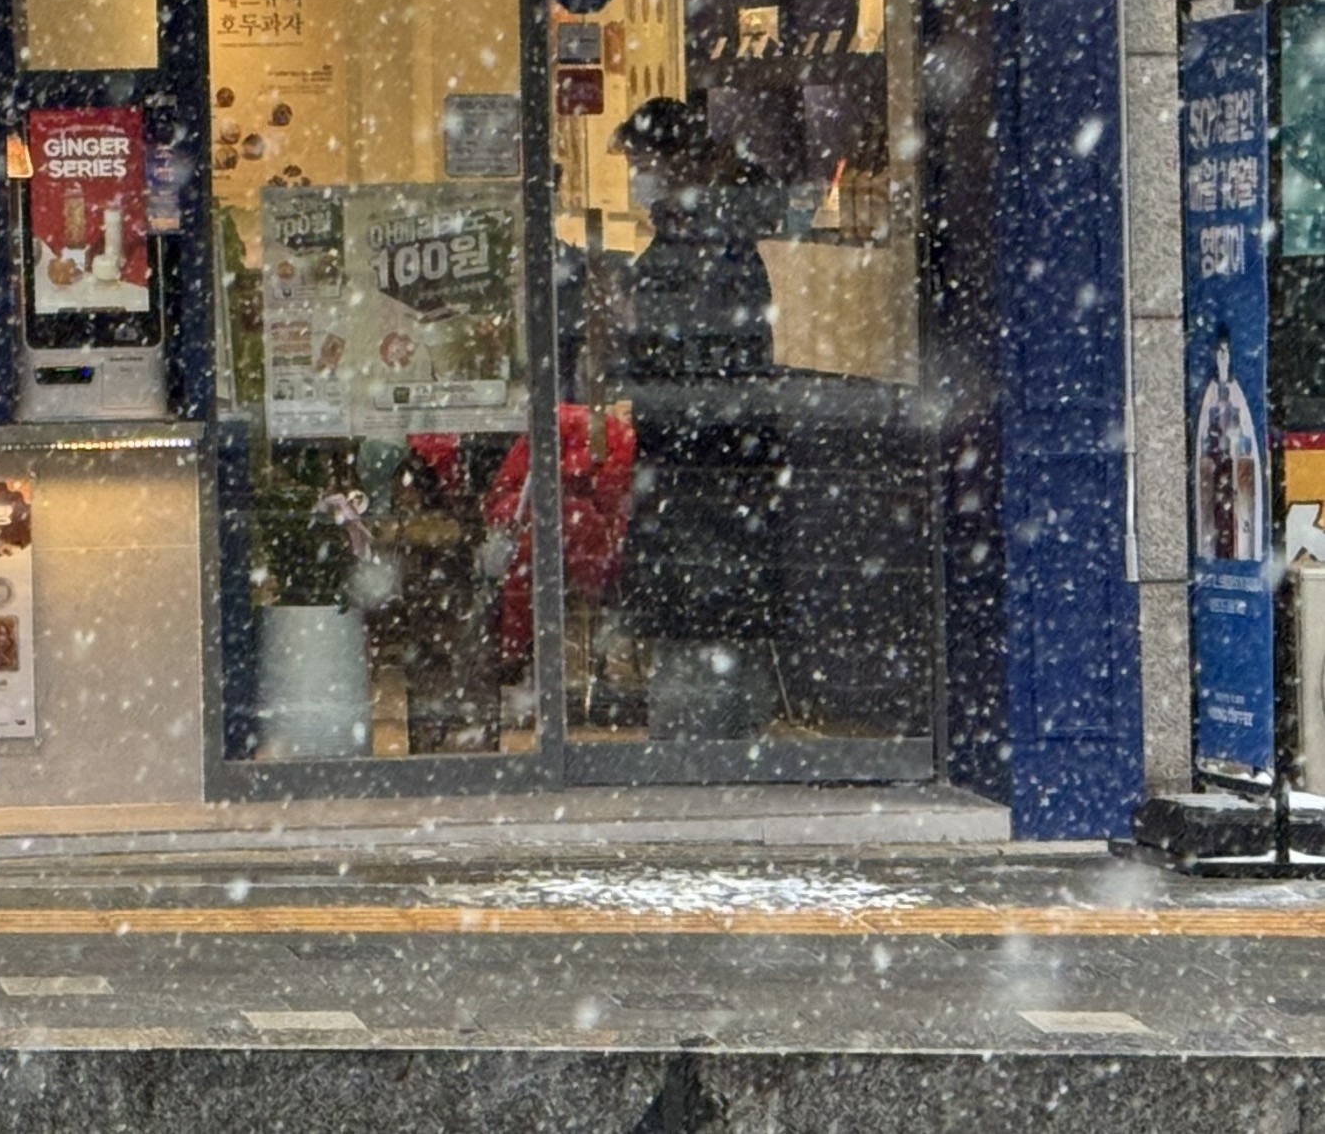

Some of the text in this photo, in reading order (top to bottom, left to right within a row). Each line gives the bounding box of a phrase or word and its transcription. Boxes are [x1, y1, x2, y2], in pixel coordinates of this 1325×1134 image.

[216, 11, 305, 38] 호두과자
[43, 136, 131, 157] GINGER
[48, 158, 127, 179] SERIES
[371, 230, 490, 290] 100원
